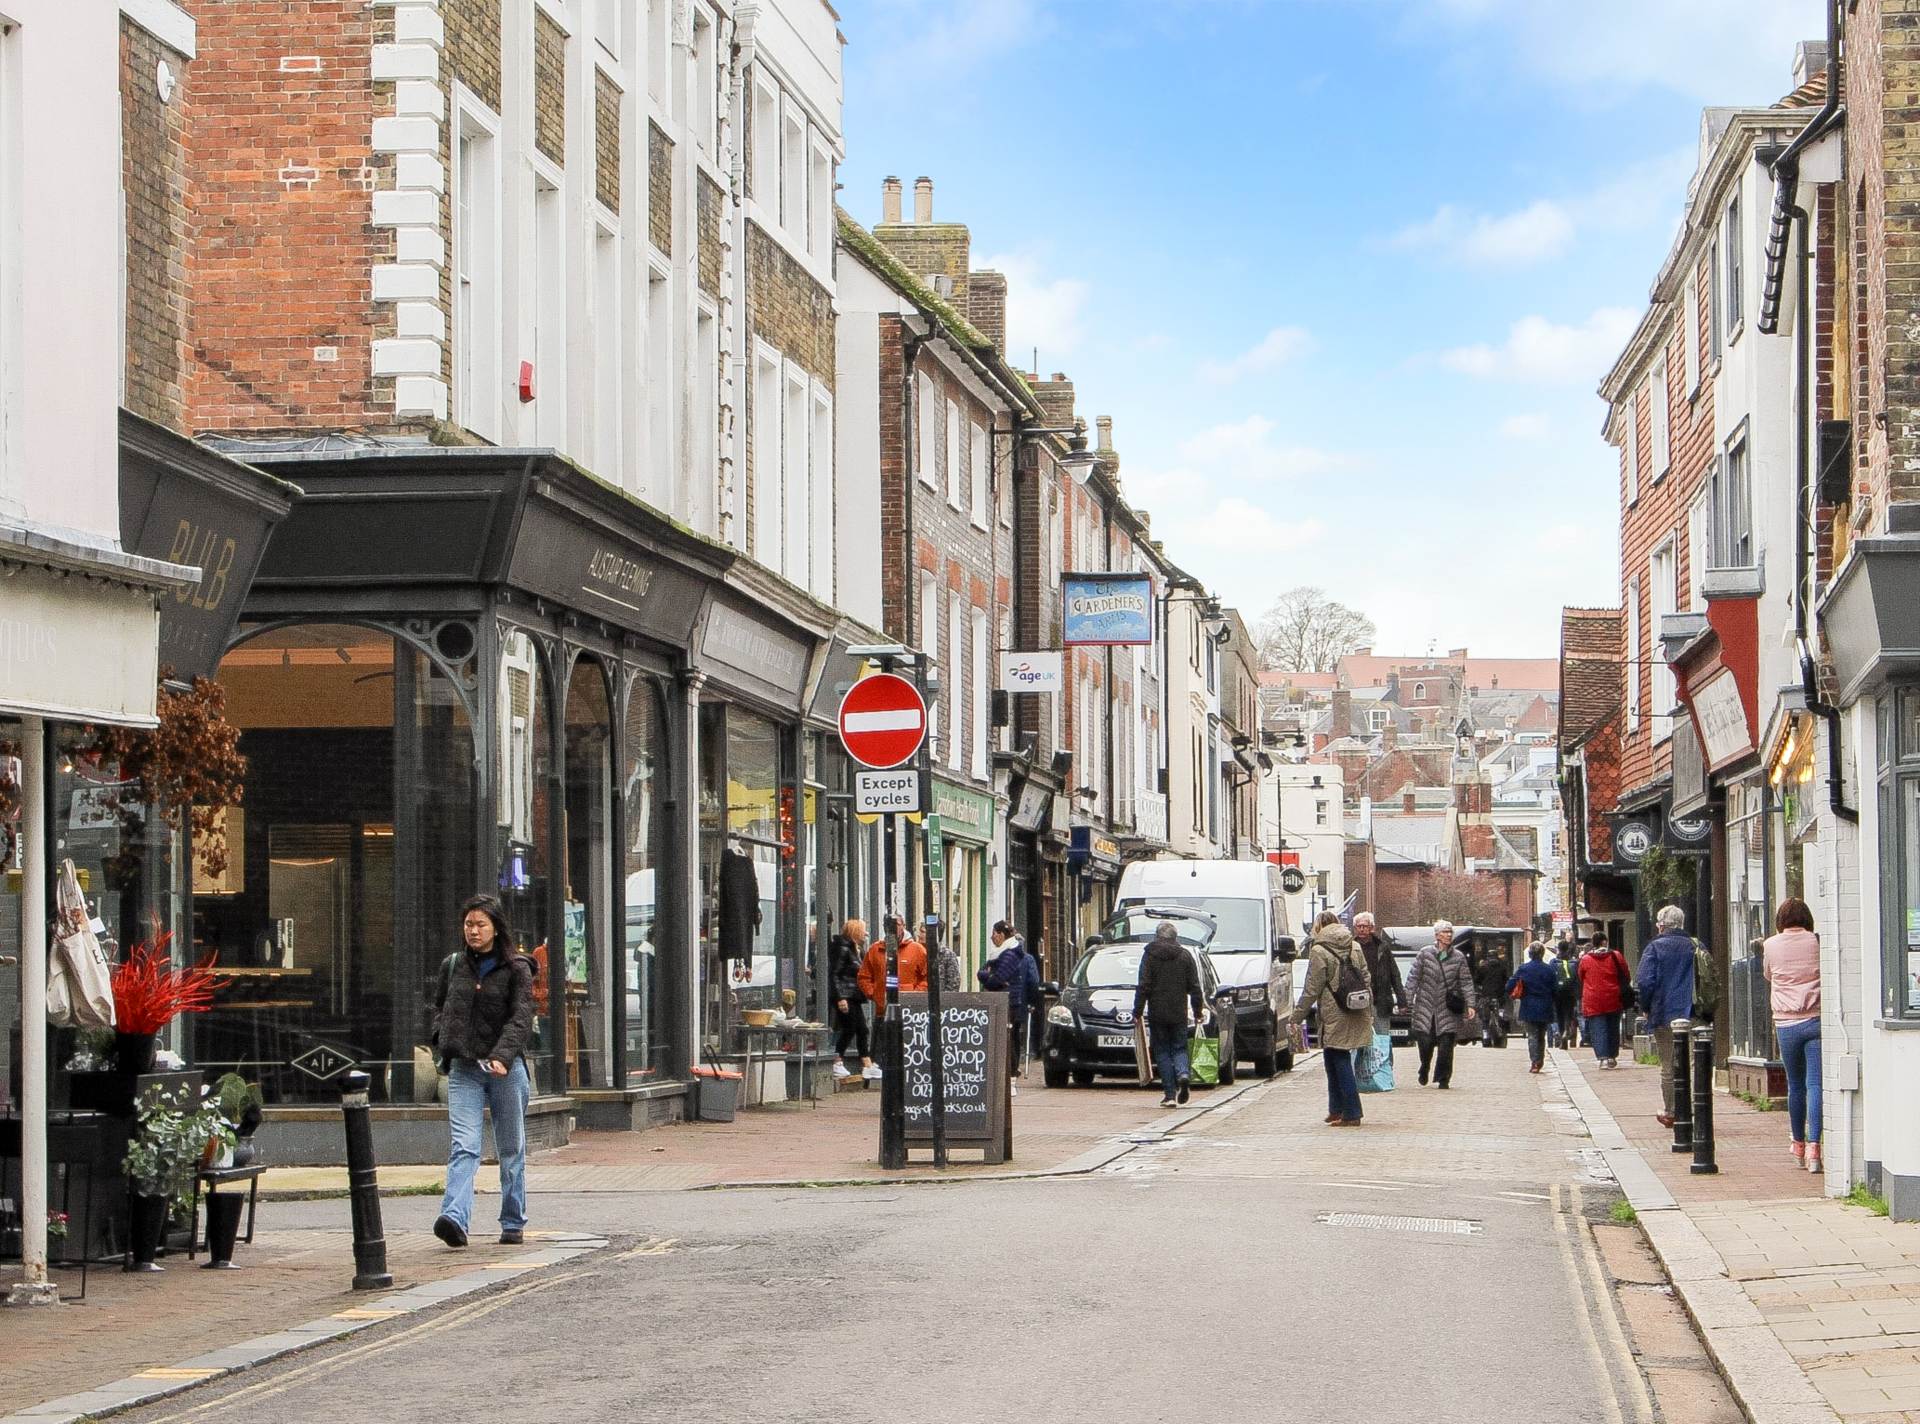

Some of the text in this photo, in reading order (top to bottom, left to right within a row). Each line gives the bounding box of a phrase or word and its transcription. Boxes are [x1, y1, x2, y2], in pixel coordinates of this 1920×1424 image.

[1019, 672, 1042, 684] age
[862, 776, 913, 790] Except
[864, 792, 911, 807] cycles
[903, 1025, 983, 1046] Chilren's
[1103, 1036, 1124, 1045] KX12
